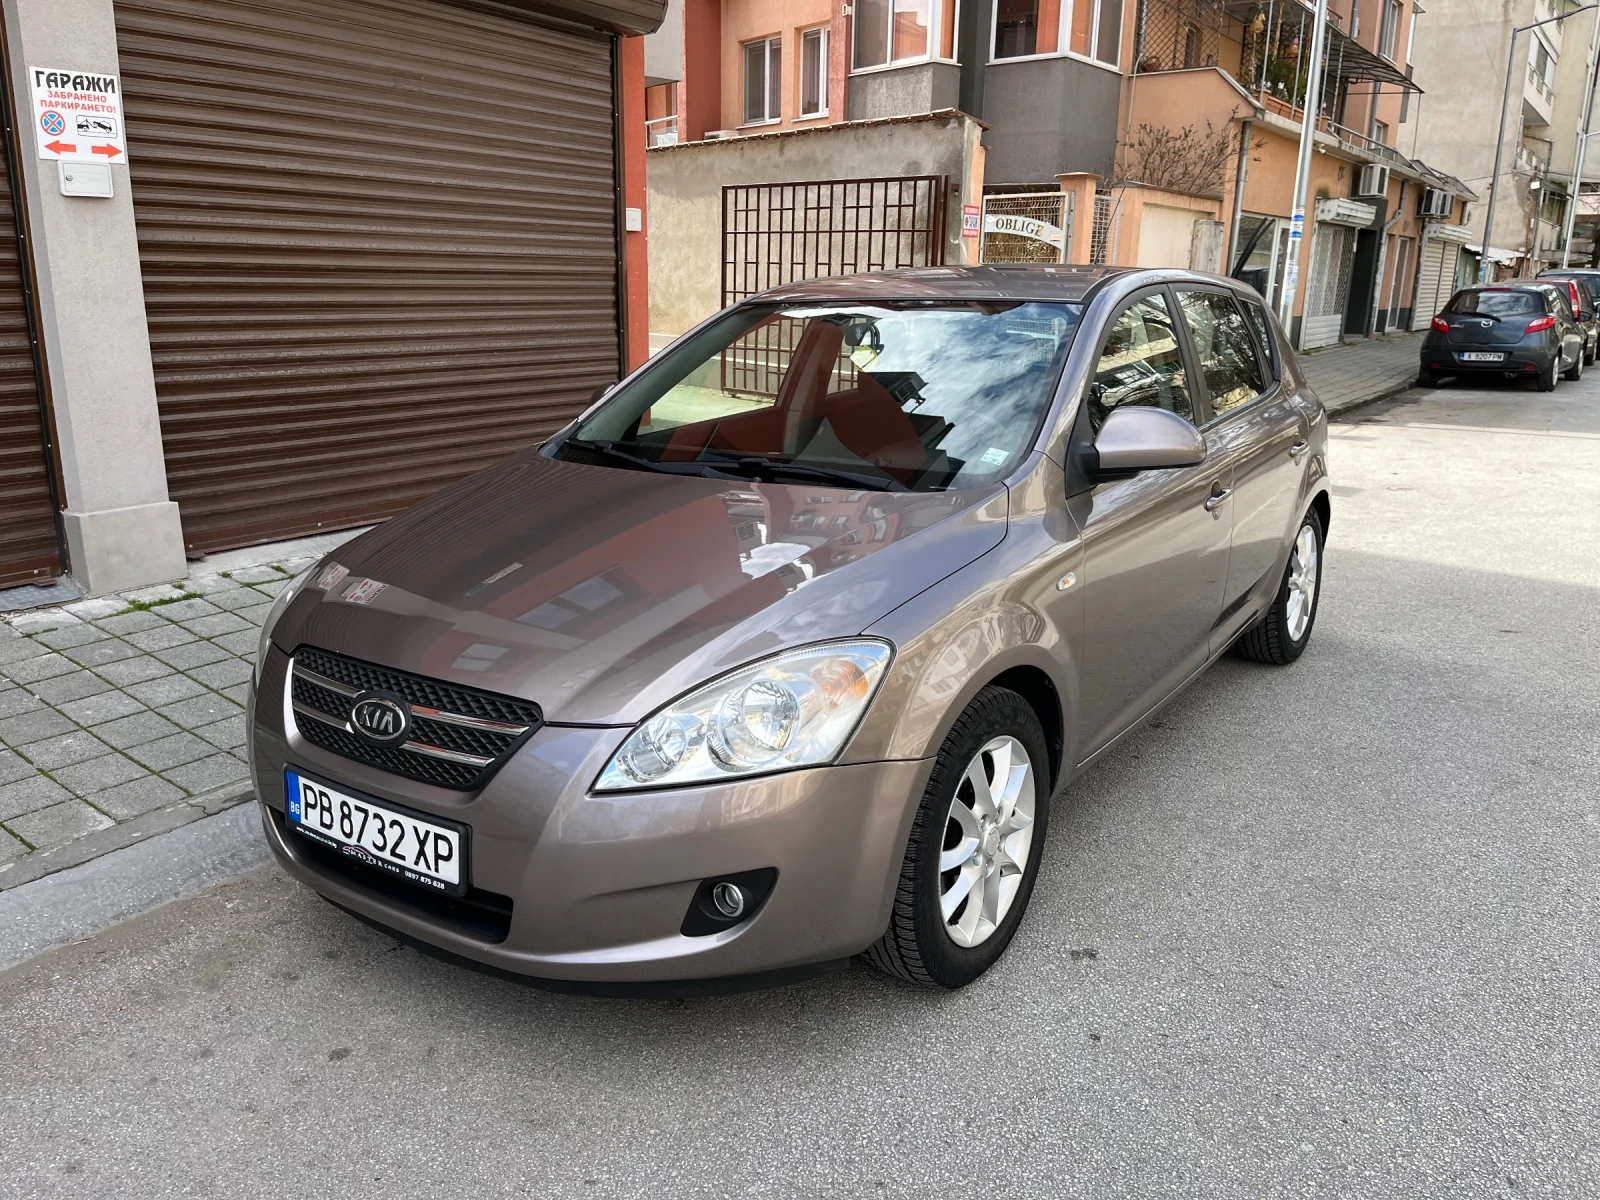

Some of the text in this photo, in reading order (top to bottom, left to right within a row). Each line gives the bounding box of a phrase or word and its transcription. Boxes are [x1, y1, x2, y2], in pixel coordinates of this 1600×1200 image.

[35, 70, 116, 94] ГАРАЖИ
[47, 90, 107, 103] ЗАБРАНЕНО
[40, 99, 117, 113] ПАРКИРАНЕТО!
[995, 217, 1044, 237] OBLIGE
[360, 704, 393, 733] KIA
[290, 800, 300, 815] BG
